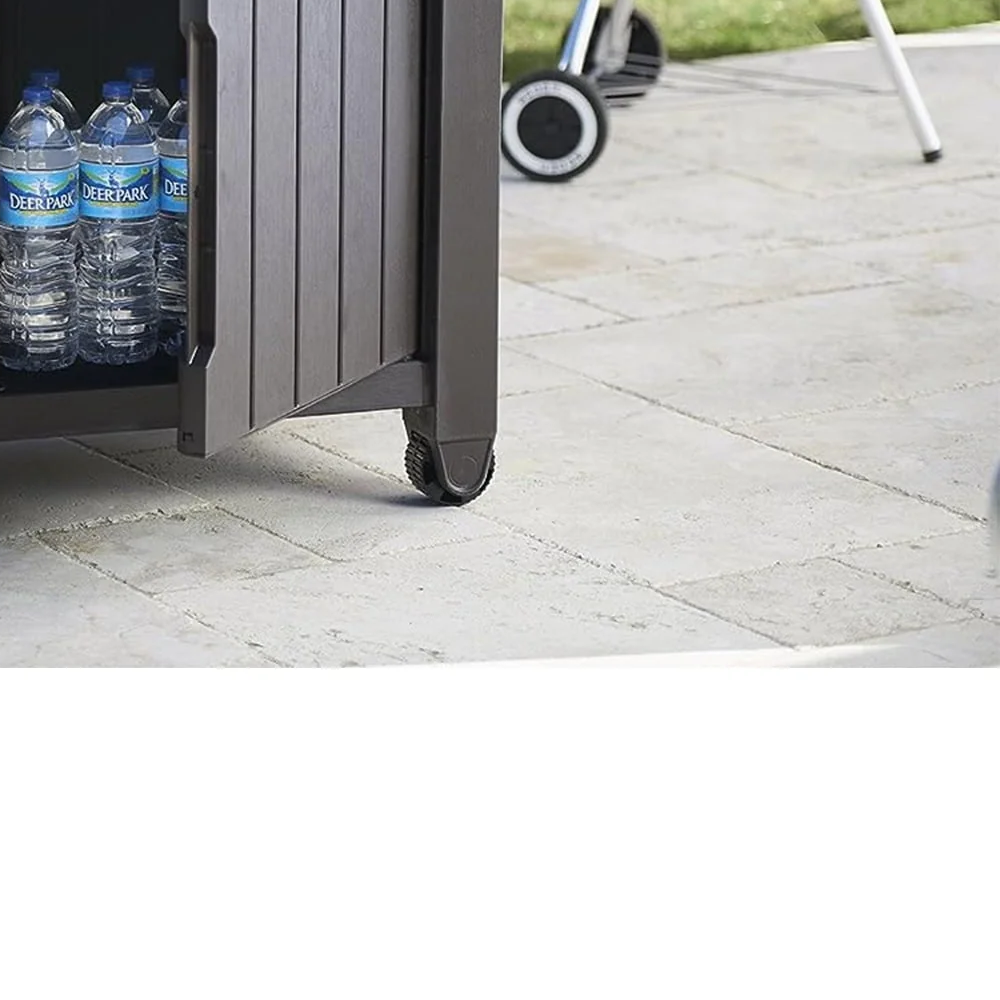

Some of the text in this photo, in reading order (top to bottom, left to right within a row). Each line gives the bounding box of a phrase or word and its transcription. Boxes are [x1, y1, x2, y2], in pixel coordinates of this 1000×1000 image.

[82, 182, 149, 202] DEER PARK
[164, 177, 187, 196] DEE
[9, 189, 76, 210] DEER PARK
